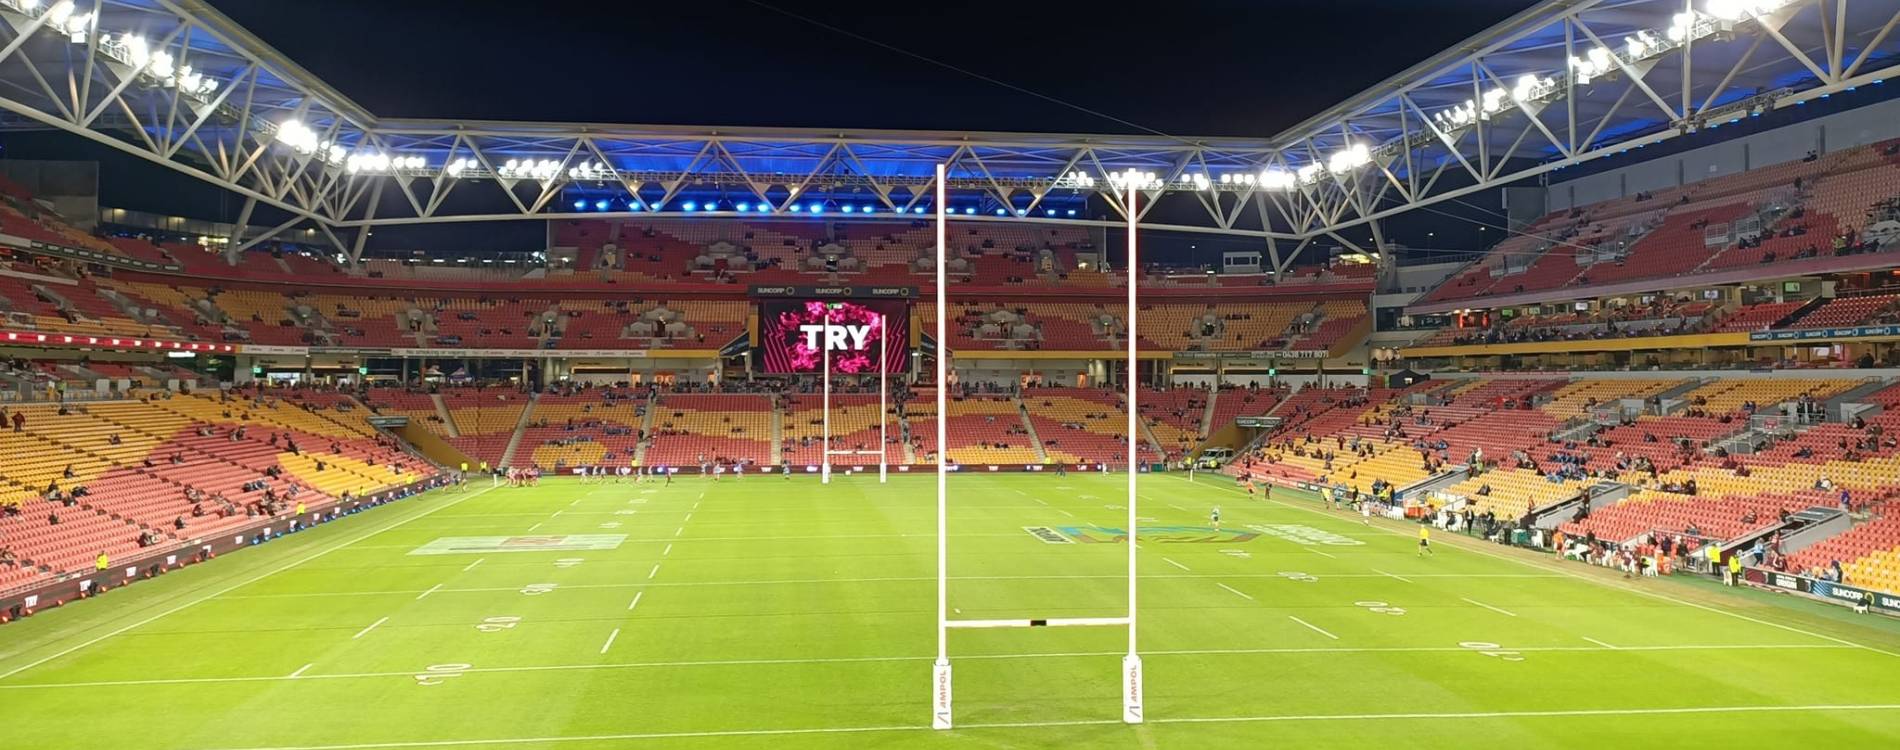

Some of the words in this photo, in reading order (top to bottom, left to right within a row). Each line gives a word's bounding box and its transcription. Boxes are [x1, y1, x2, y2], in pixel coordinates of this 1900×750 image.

[799, 324, 872, 350] TRY
[1832, 587, 1863, 600] SUNCORP
[939, 670, 947, 709] AMPOL
